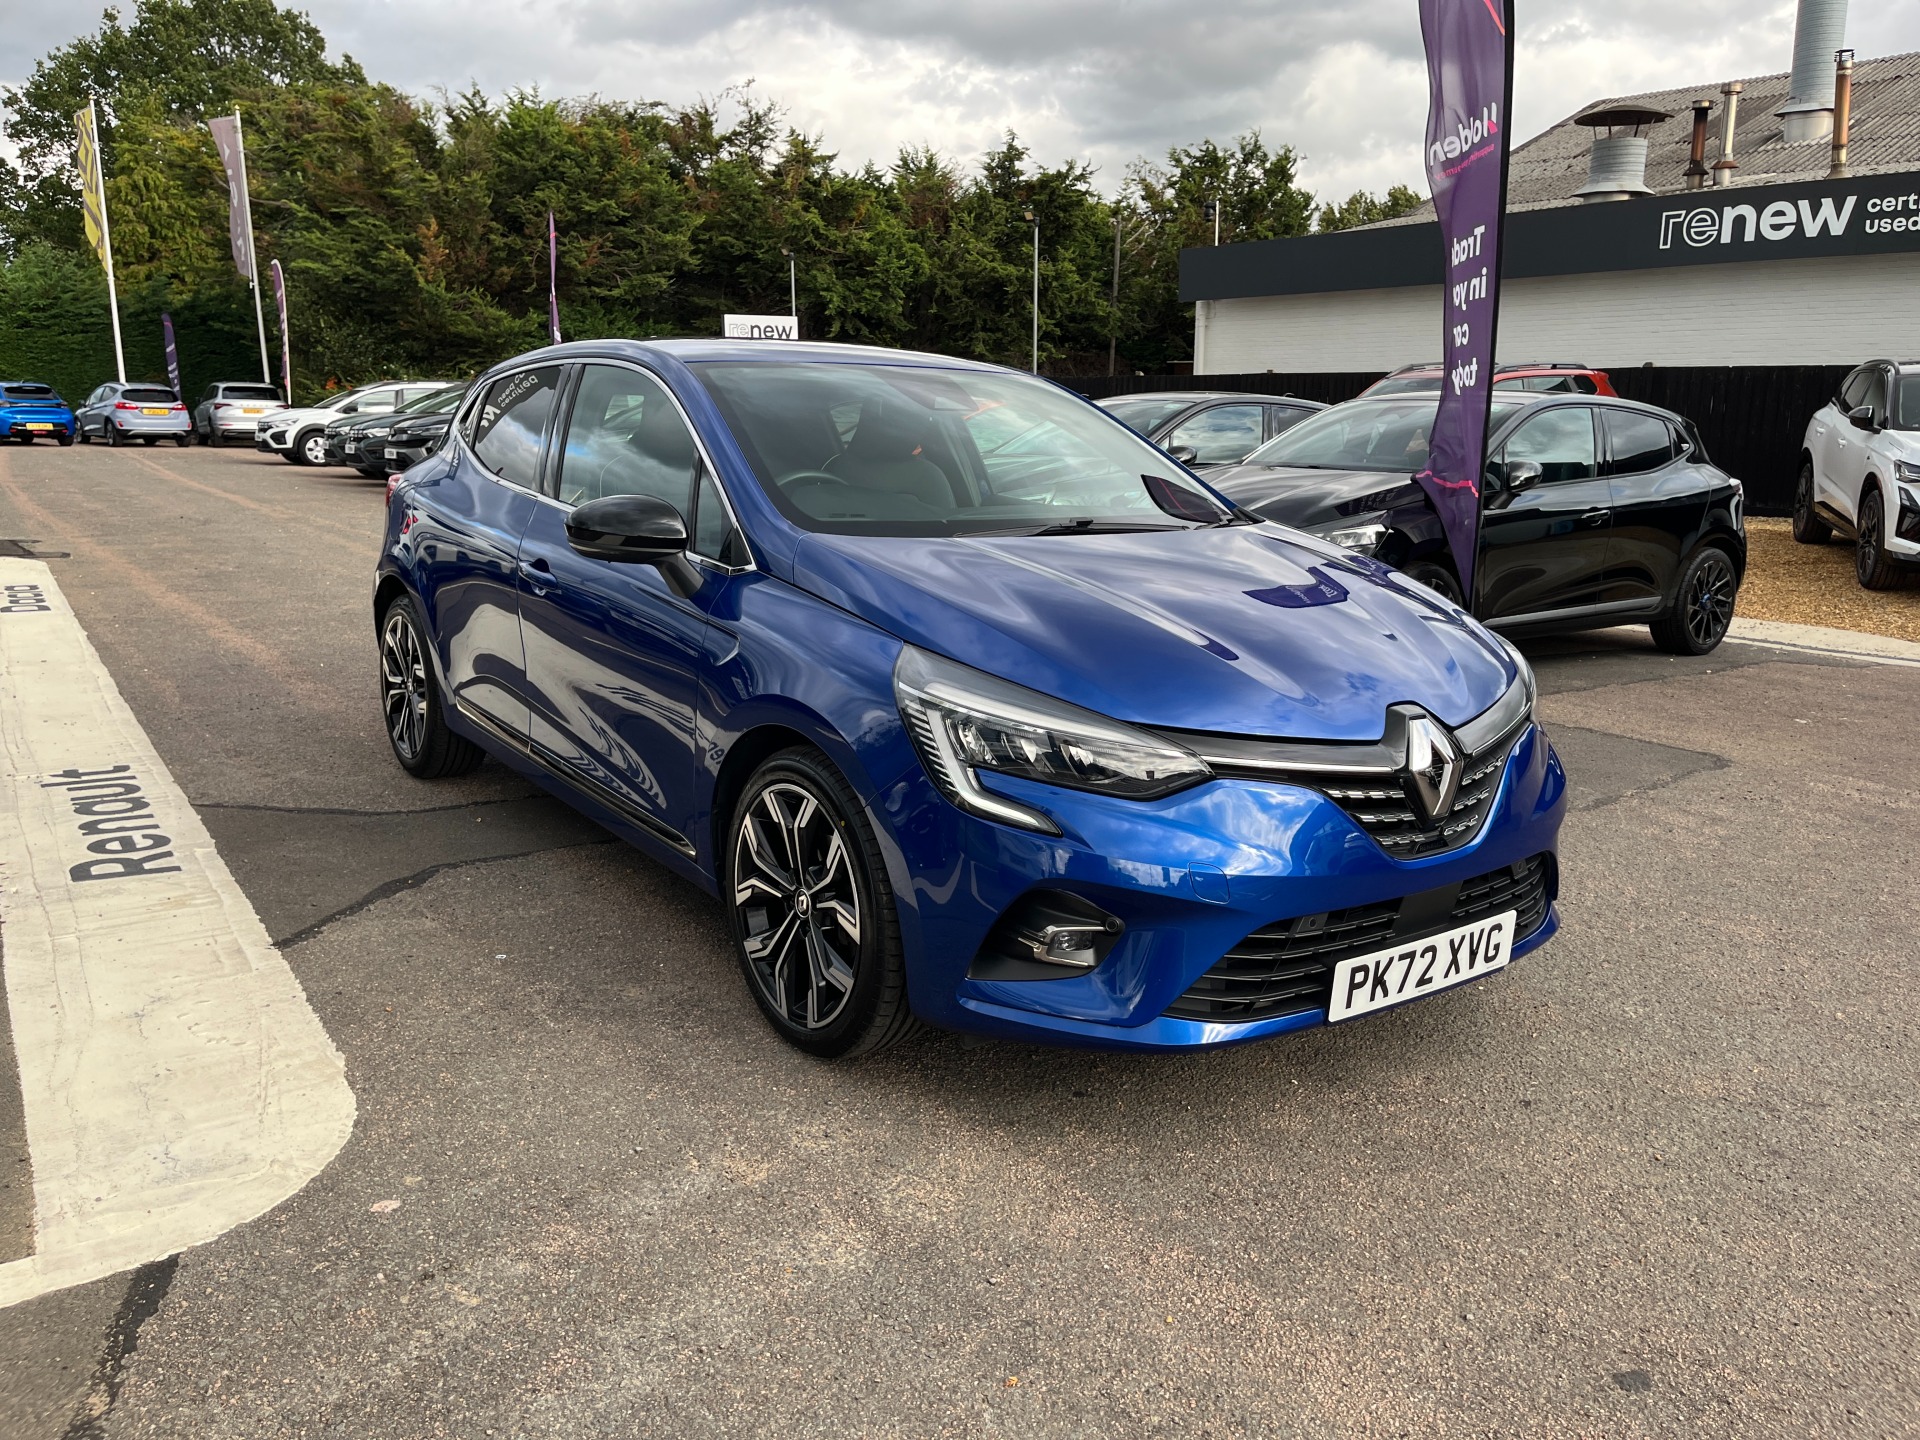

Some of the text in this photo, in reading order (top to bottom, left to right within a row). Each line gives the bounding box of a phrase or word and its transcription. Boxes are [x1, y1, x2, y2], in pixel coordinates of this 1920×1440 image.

[1659, 195, 1858, 250] renew
[1866, 192, 1920, 213] cert
[728, 321, 793, 340] renew
[0, 583, 51, 613] Dacia
[41, 764, 182, 883] Renault
[1345, 922, 1503, 1009] PK72 XVG
